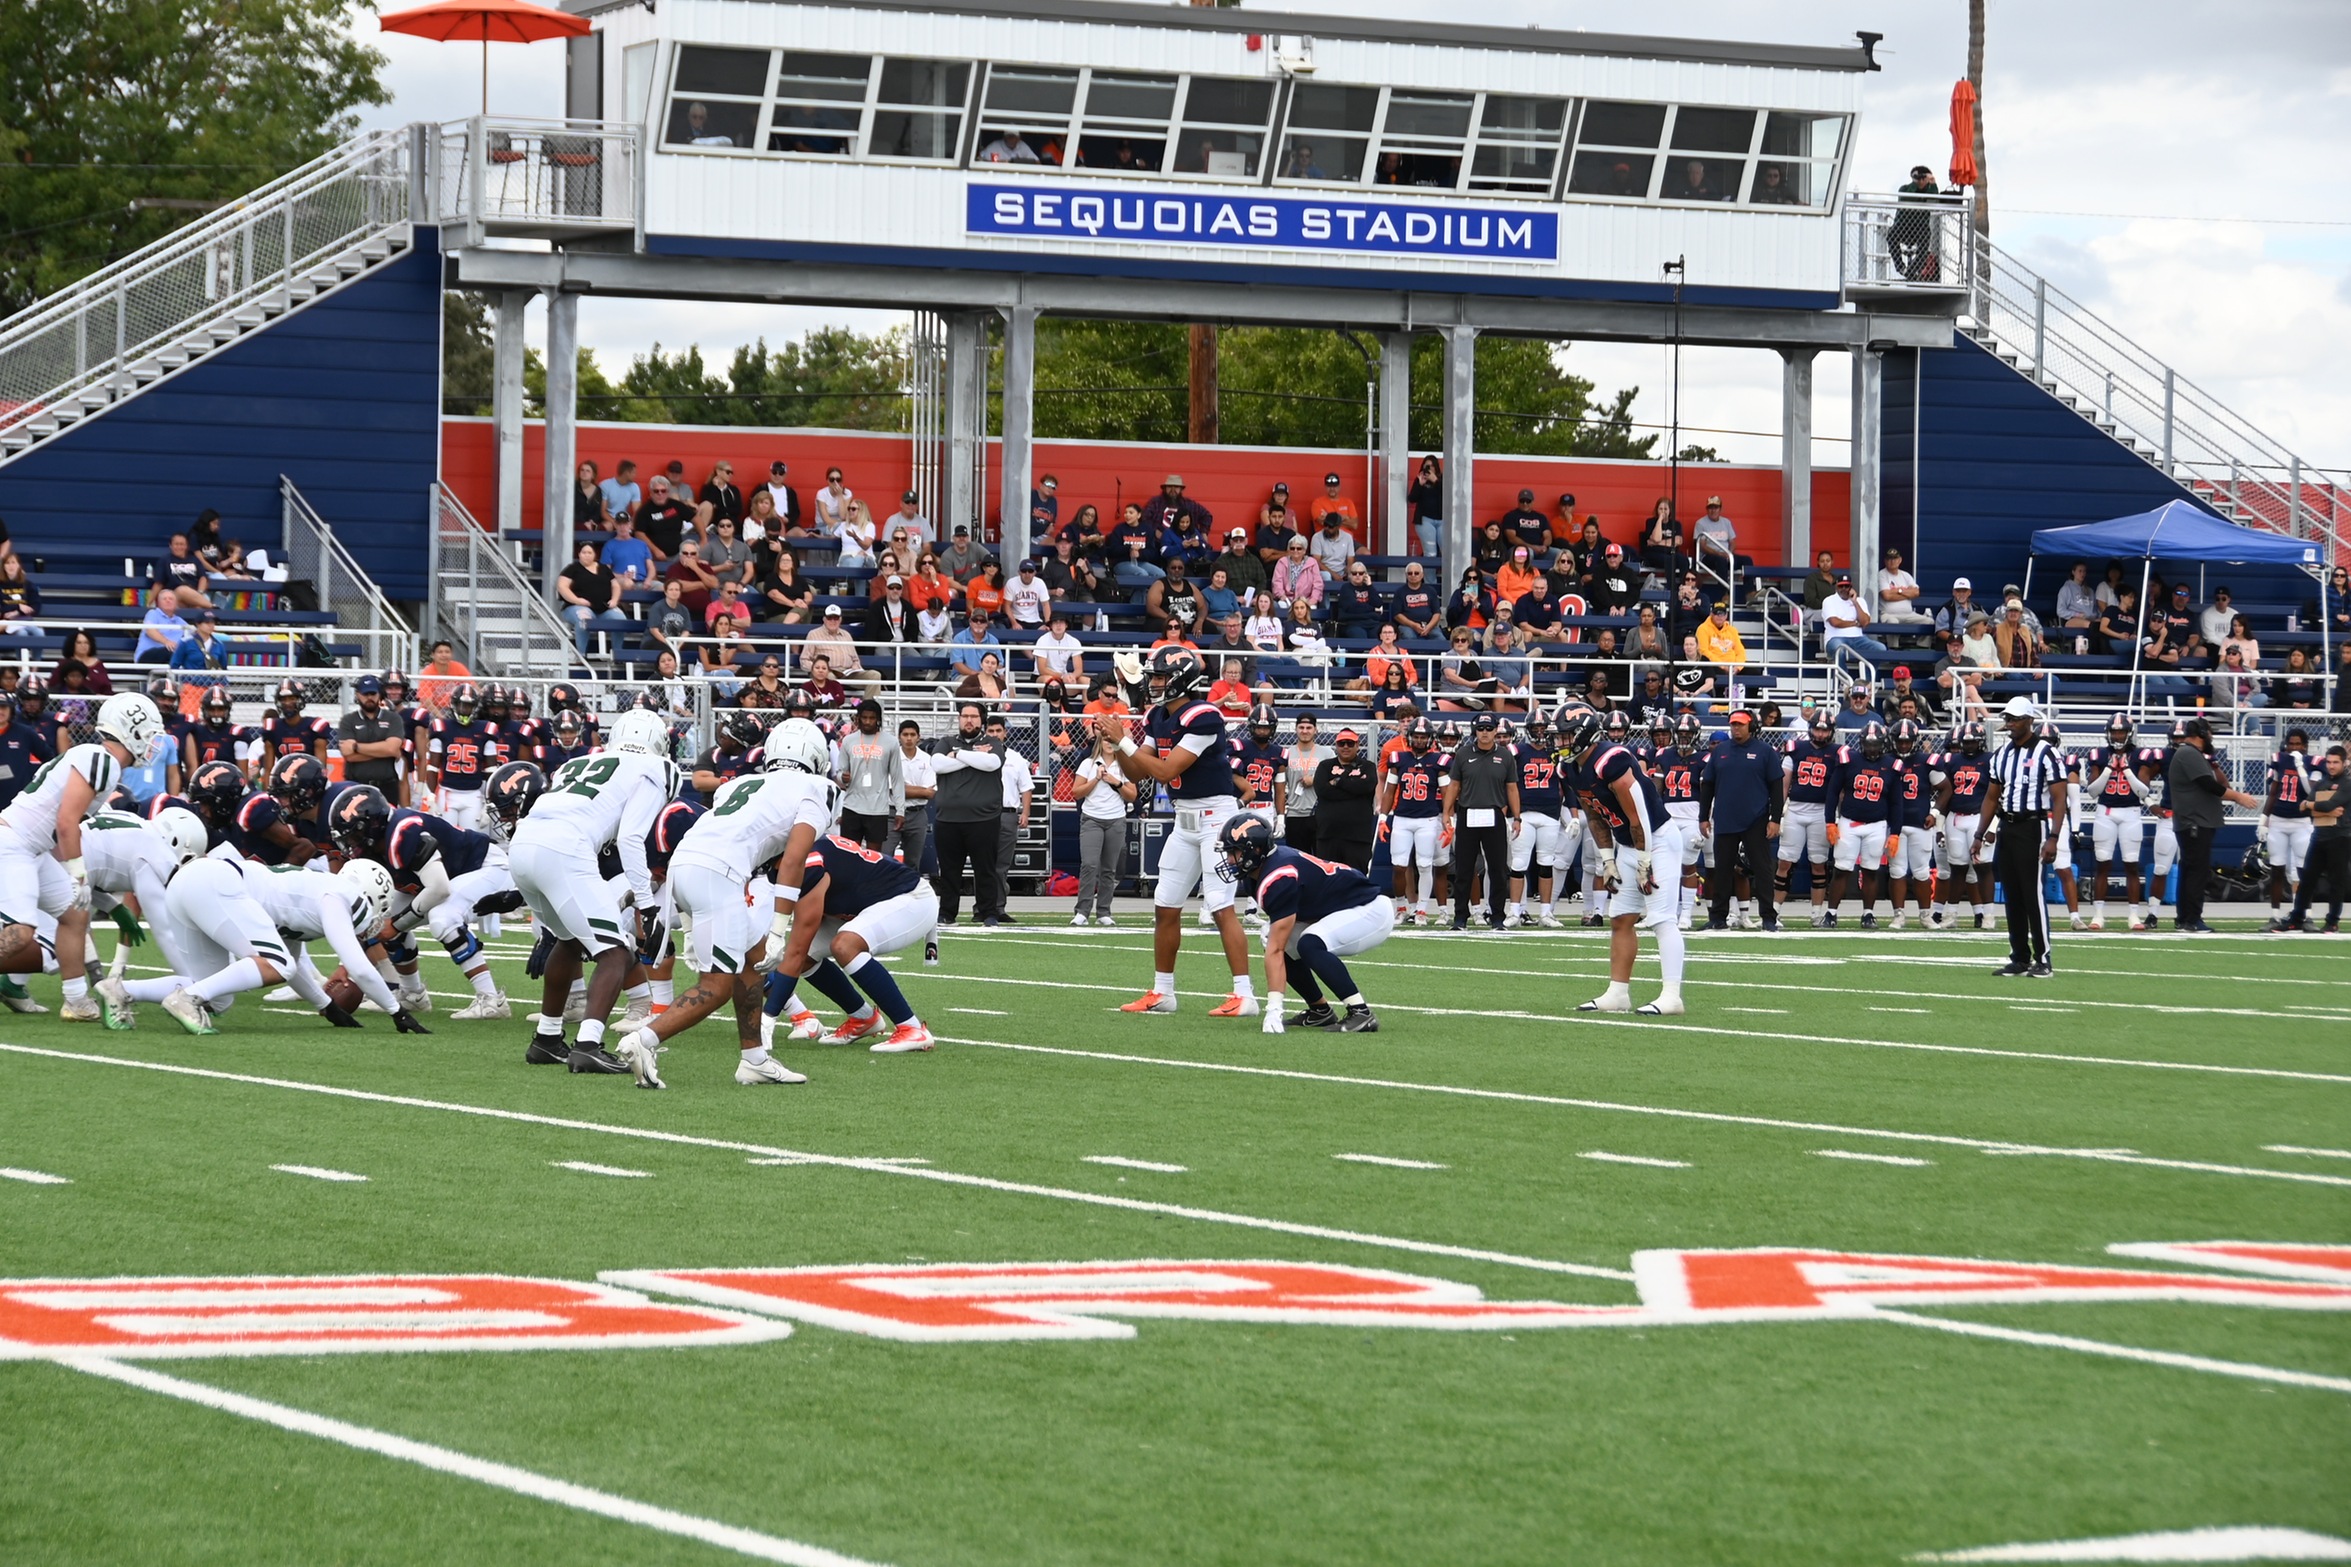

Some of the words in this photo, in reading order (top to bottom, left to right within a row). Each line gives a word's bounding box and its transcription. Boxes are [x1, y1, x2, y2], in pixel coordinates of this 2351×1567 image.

[993, 191, 1279, 236] SEQUOIAS
[1301, 205, 1532, 250] STADIUM
[126, 704, 148, 726] 33
[446, 743, 478, 774] 25
[623, 743, 646, 751] schutt
[776, 759, 800, 768] schutt
[1523, 763, 1555, 789] 27
[1797, 761, 1827, 788] 58
[547, 757, 620, 801] 32
[1246, 763, 1274, 793] 28
[1401, 772, 1430, 801] 36
[1665, 770, 1692, 798] 44
[1853, 774, 1884, 802] 99
[1953, 771, 1981, 795] 97
[2279, 775, 2298, 803] 11
[714, 779, 765, 816] 8
[375, 871, 392, 894] 55
